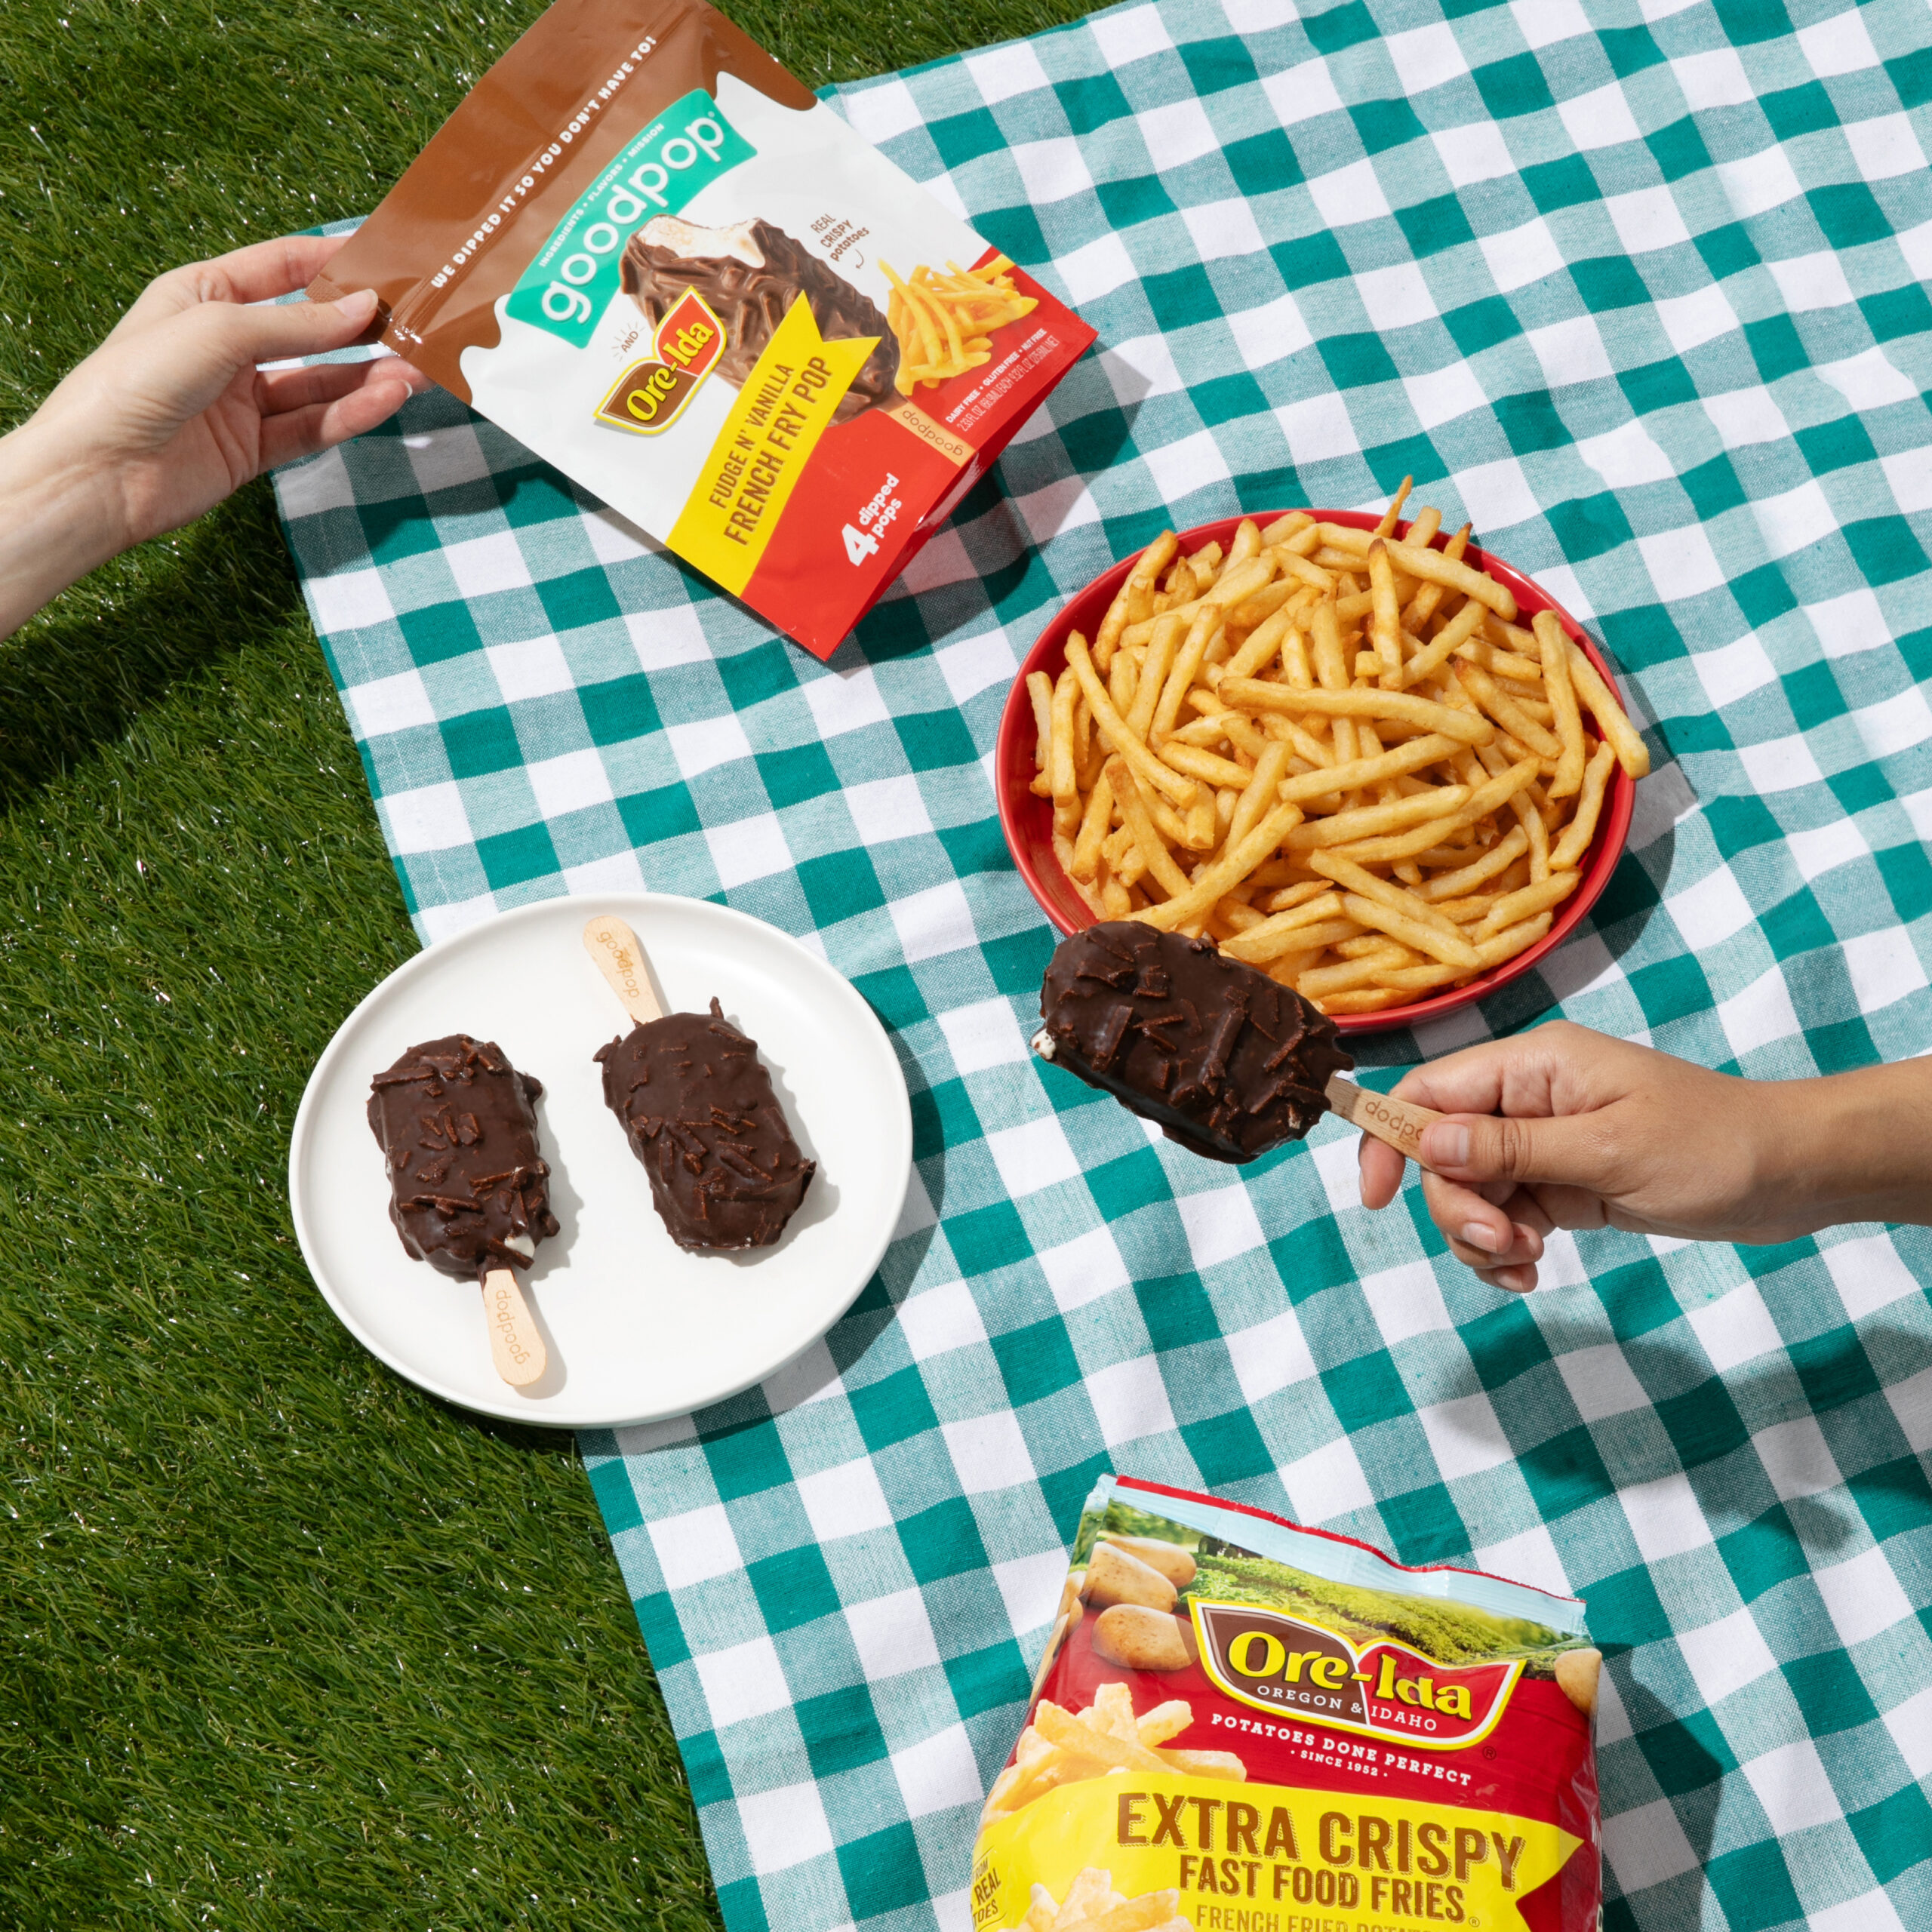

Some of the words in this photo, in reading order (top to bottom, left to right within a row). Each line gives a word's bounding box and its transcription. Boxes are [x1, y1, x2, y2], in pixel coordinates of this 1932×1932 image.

[430, 265, 456, 288] WE
[453, 214, 501, 264] DIPPED
[499, 195, 516, 213] IT
[515, 175, 534, 196] SO
[531, 143, 561, 174] YOU
[559, 100, 600, 143] DON'T
[598, 62, 634, 100] HAVE
[630, 35, 657, 60] TO!
[539, 208, 584, 267] INGREDIENTS
[587, 163, 623, 202] FLAVORS
[628, 123, 665, 158] MISSION
[542, 117, 724, 324] goodpop
[811, 214, 836, 234] REAL
[820, 220, 853, 248] CRISPY
[830, 227, 869, 262] potatoes
[620, 331, 638, 353] AND
[626, 321, 715, 421] Ore-Ida
[945, 402, 966, 423] DAIRY
[963, 389, 981, 406] FREE
[983, 361, 1007, 386] GLUTEN
[1003, 351, 1020, 367] FREE
[1021, 337, 1035, 351] NUT
[1032, 328, 1048, 343] FREE
[995, 376, 1014, 393] EACH
[709, 451, 747, 509] FUDGE
[735, 429, 755, 451] N'
[746, 364, 794, 427] VANILLA
[723, 450, 783, 546] FRENCH
[767, 401, 808, 451] FRY
[792, 356, 832, 404] POP
[859, 472, 900, 525] dipped
[871, 498, 902, 539] pops
[841, 523, 880, 566] 4
[1226, 1630, 1473, 1721] Ore-Ida
[1257, 1684, 1343, 1710] OREGON
[1350, 1702, 1363, 1715] &
[1371, 1706, 1437, 1731] IDAHO
[1211, 1713, 1315, 1746] POTATOES
[1322, 1737, 1377, 1761] DONE
[1384, 1752, 1472, 1786] PERFECT
[1300, 1749, 1343, 1768] SINCE
[1347, 1760, 1379, 1777] 1952
[1117, 1792, 1302, 1863] EXTRA
[1318, 1810, 1527, 1893] CRISPY
[974, 1867, 1001, 1906] REAL
[1180, 1854, 1263, 1899] FAST
[1272, 1864, 1359, 1909] FOOD
[1371, 1876, 1466, 1924] FRIES
[1196, 1904, 1279, 1932] FRENCH
